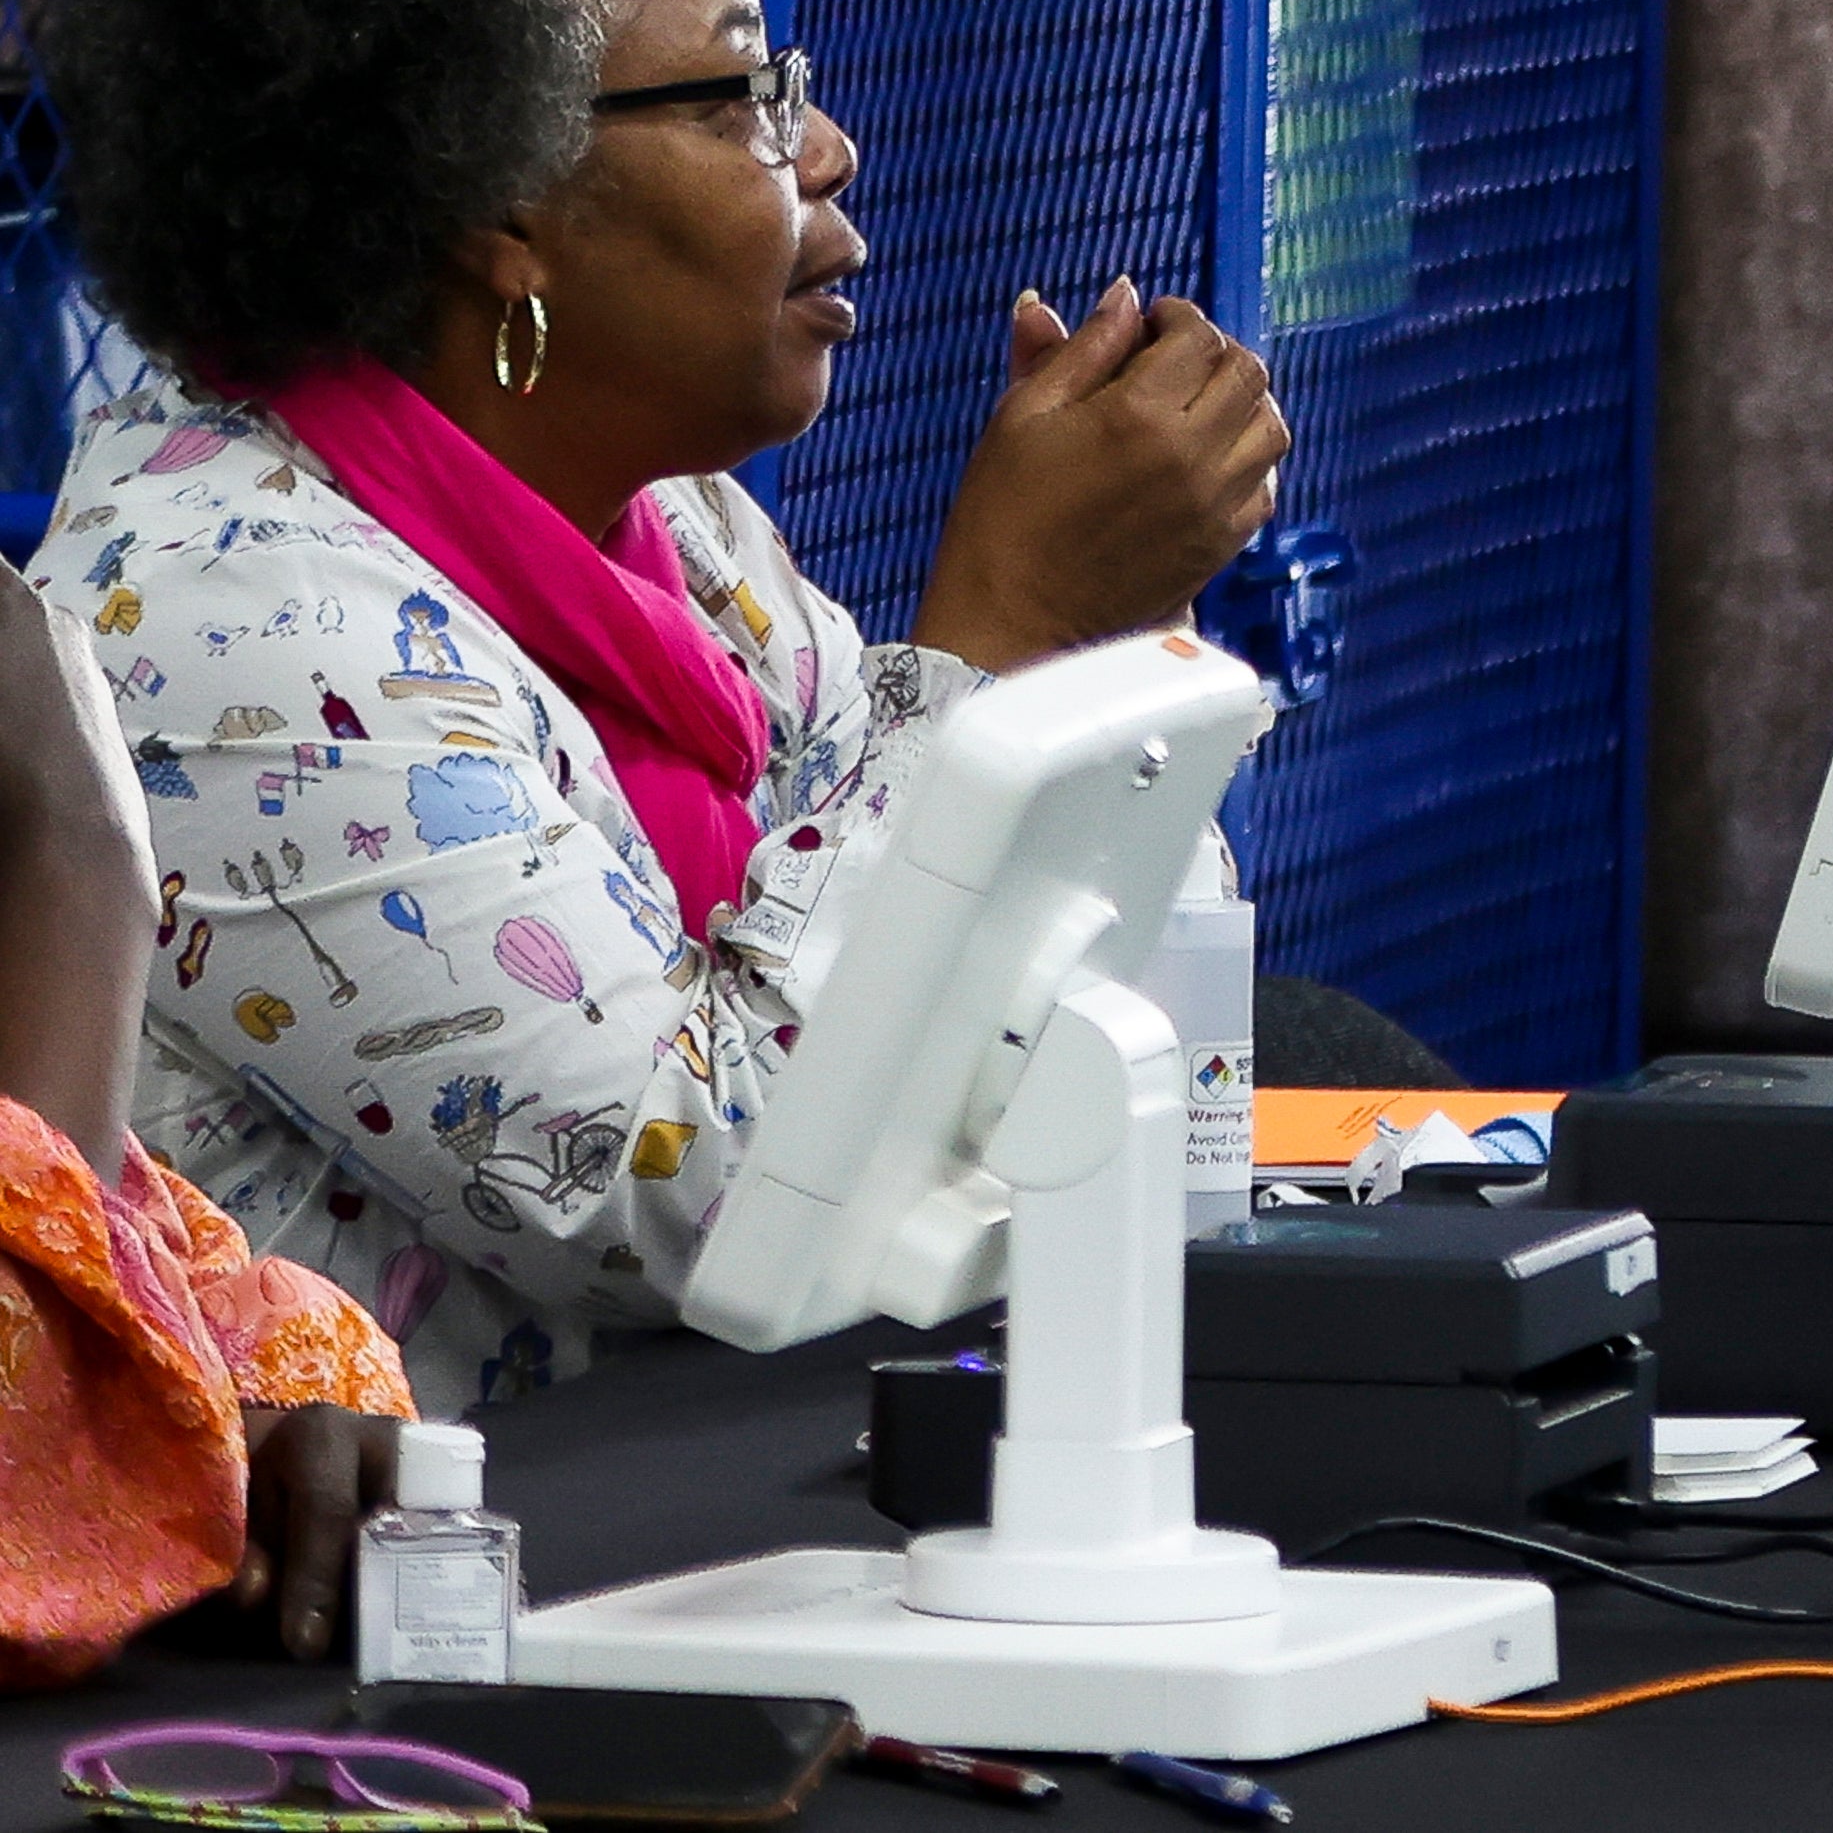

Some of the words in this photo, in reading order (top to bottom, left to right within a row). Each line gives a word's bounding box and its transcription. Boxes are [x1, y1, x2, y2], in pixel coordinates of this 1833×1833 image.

[1187, 1109, 1245, 1124] Warning
[1186, 1131, 1228, 1147] Avoid
[1185, 1151, 1207, 1165] Do
